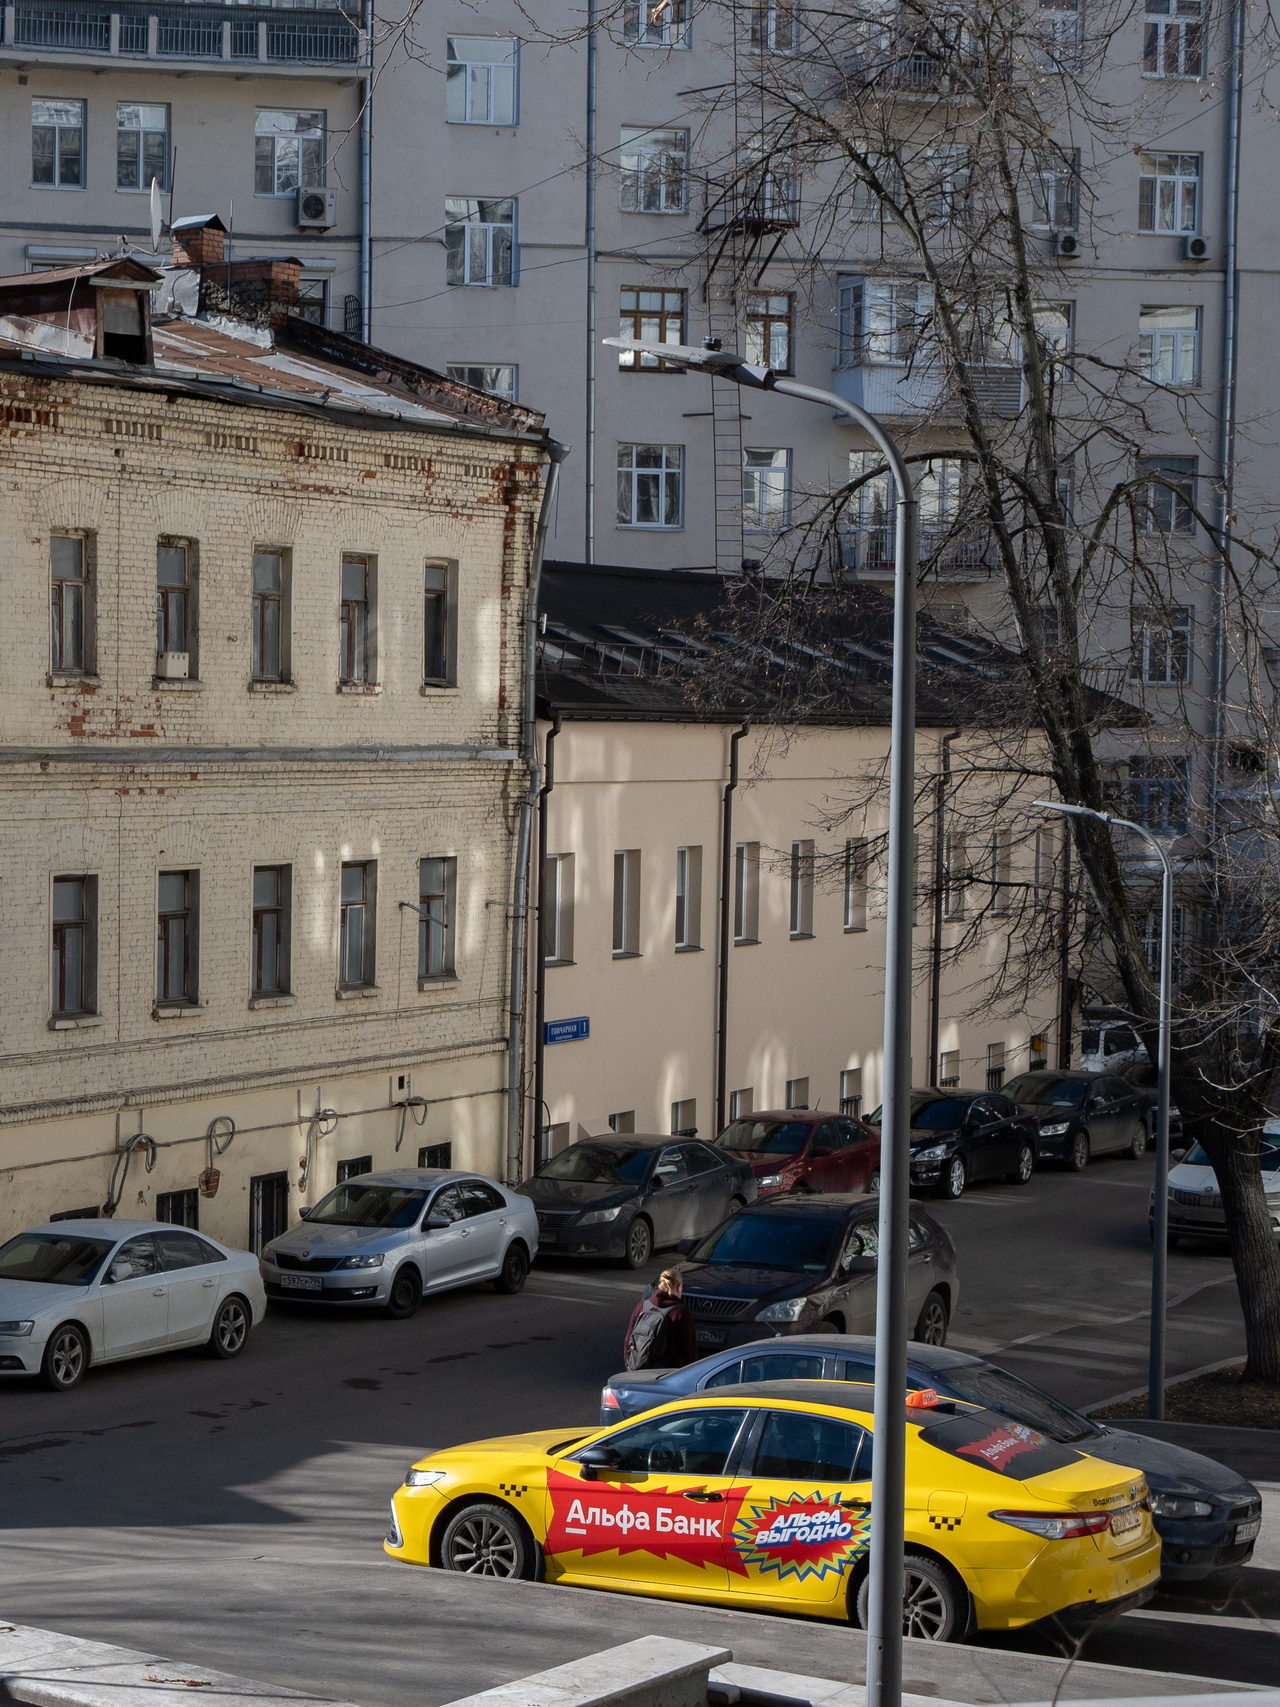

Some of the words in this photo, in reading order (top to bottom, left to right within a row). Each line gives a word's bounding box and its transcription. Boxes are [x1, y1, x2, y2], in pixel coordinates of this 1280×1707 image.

[566, 1499, 650, 1535] Альфа
[656, 1507, 721, 1538] Банк
[771, 1509, 841, 1529] АЛЬФА
[755, 1522, 852, 1545] ВЫГОДНО
